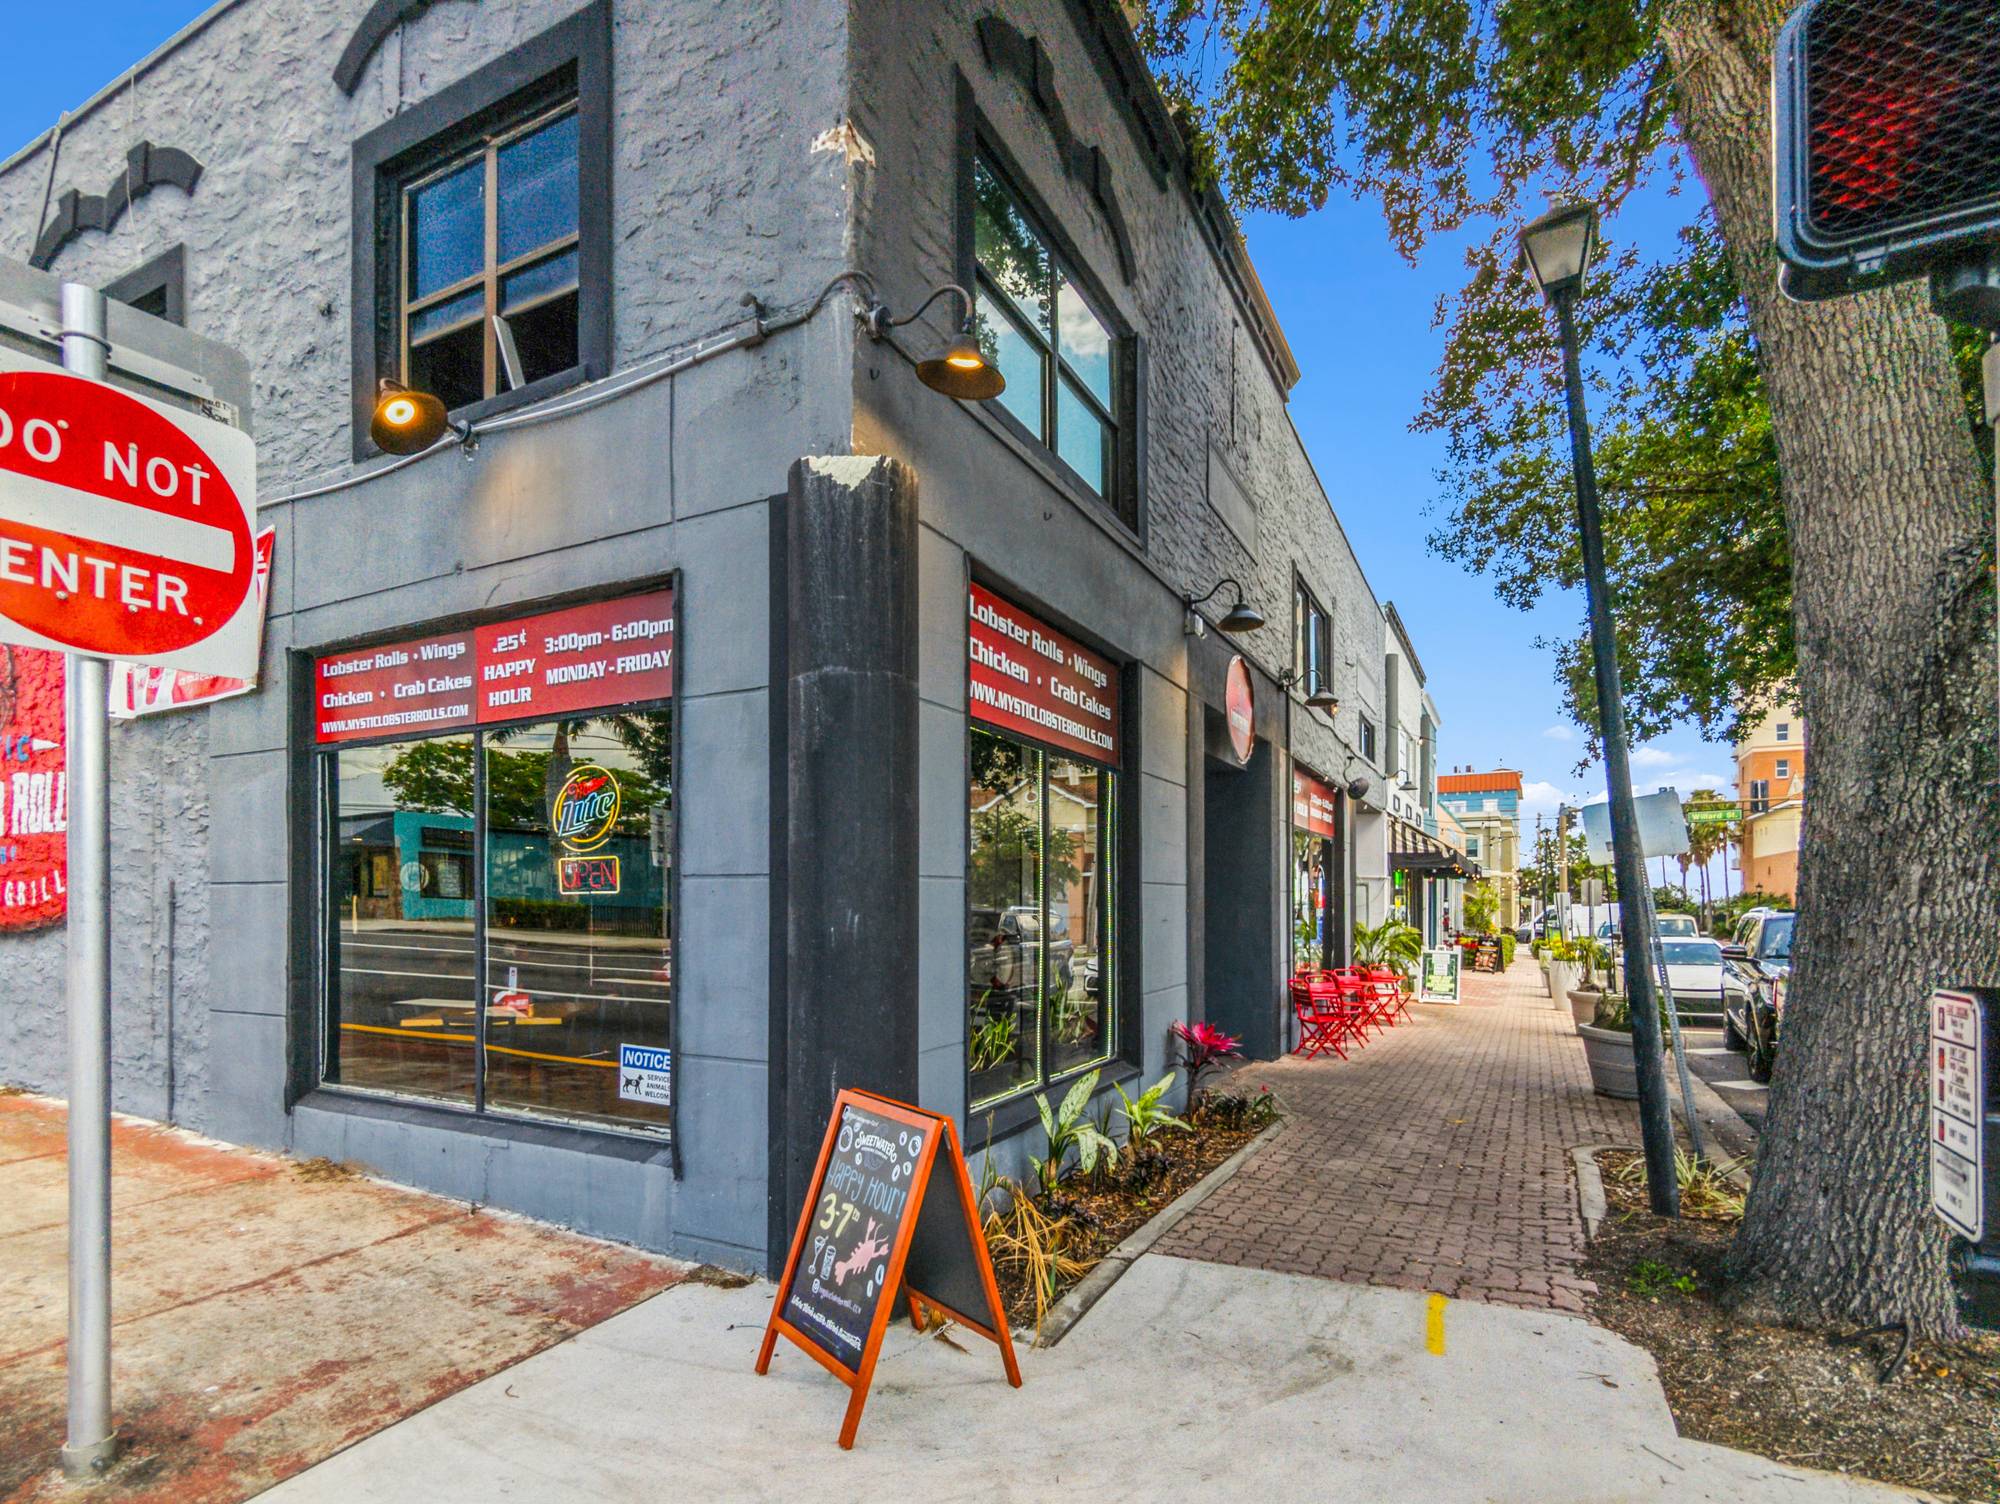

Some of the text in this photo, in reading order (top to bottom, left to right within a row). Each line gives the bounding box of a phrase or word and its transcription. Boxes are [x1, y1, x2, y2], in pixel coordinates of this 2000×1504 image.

[104, 440, 210, 506] NOT
[0, 537, 189, 616] ENTER
[544, 632, 601, 653] 3:00pm
[612, 618, 674, 642] 6:00pm
[970, 594, 1107, 688] Lobster Rolls Wings
[322, 642, 465, 677] Lobster Rolls Wings
[484, 658, 536, 681] HAPPY
[546, 660, 607, 685] MONDAY
[617, 649, 672, 674] FRIDAY
[322, 675, 472, 708] Chicken Crab Cakes
[970, 636, 1111, 720] Chicken Crab Cakes
[488, 687, 532, 707] HOUR
[322, 704, 469, 733] WWW.MYSTICLOBSTERROLLS.COM
[970, 680, 1113, 750] WW.MYSTICLOBSTERROLLS.COM
[558, 792, 616, 837] Lite
[4, 869, 66, 907] GRILL
[562, 860, 617, 888] OPEN
[624, 1050, 671, 1070] NOTICE
[854, 1131, 898, 1163] SWEETWATER
